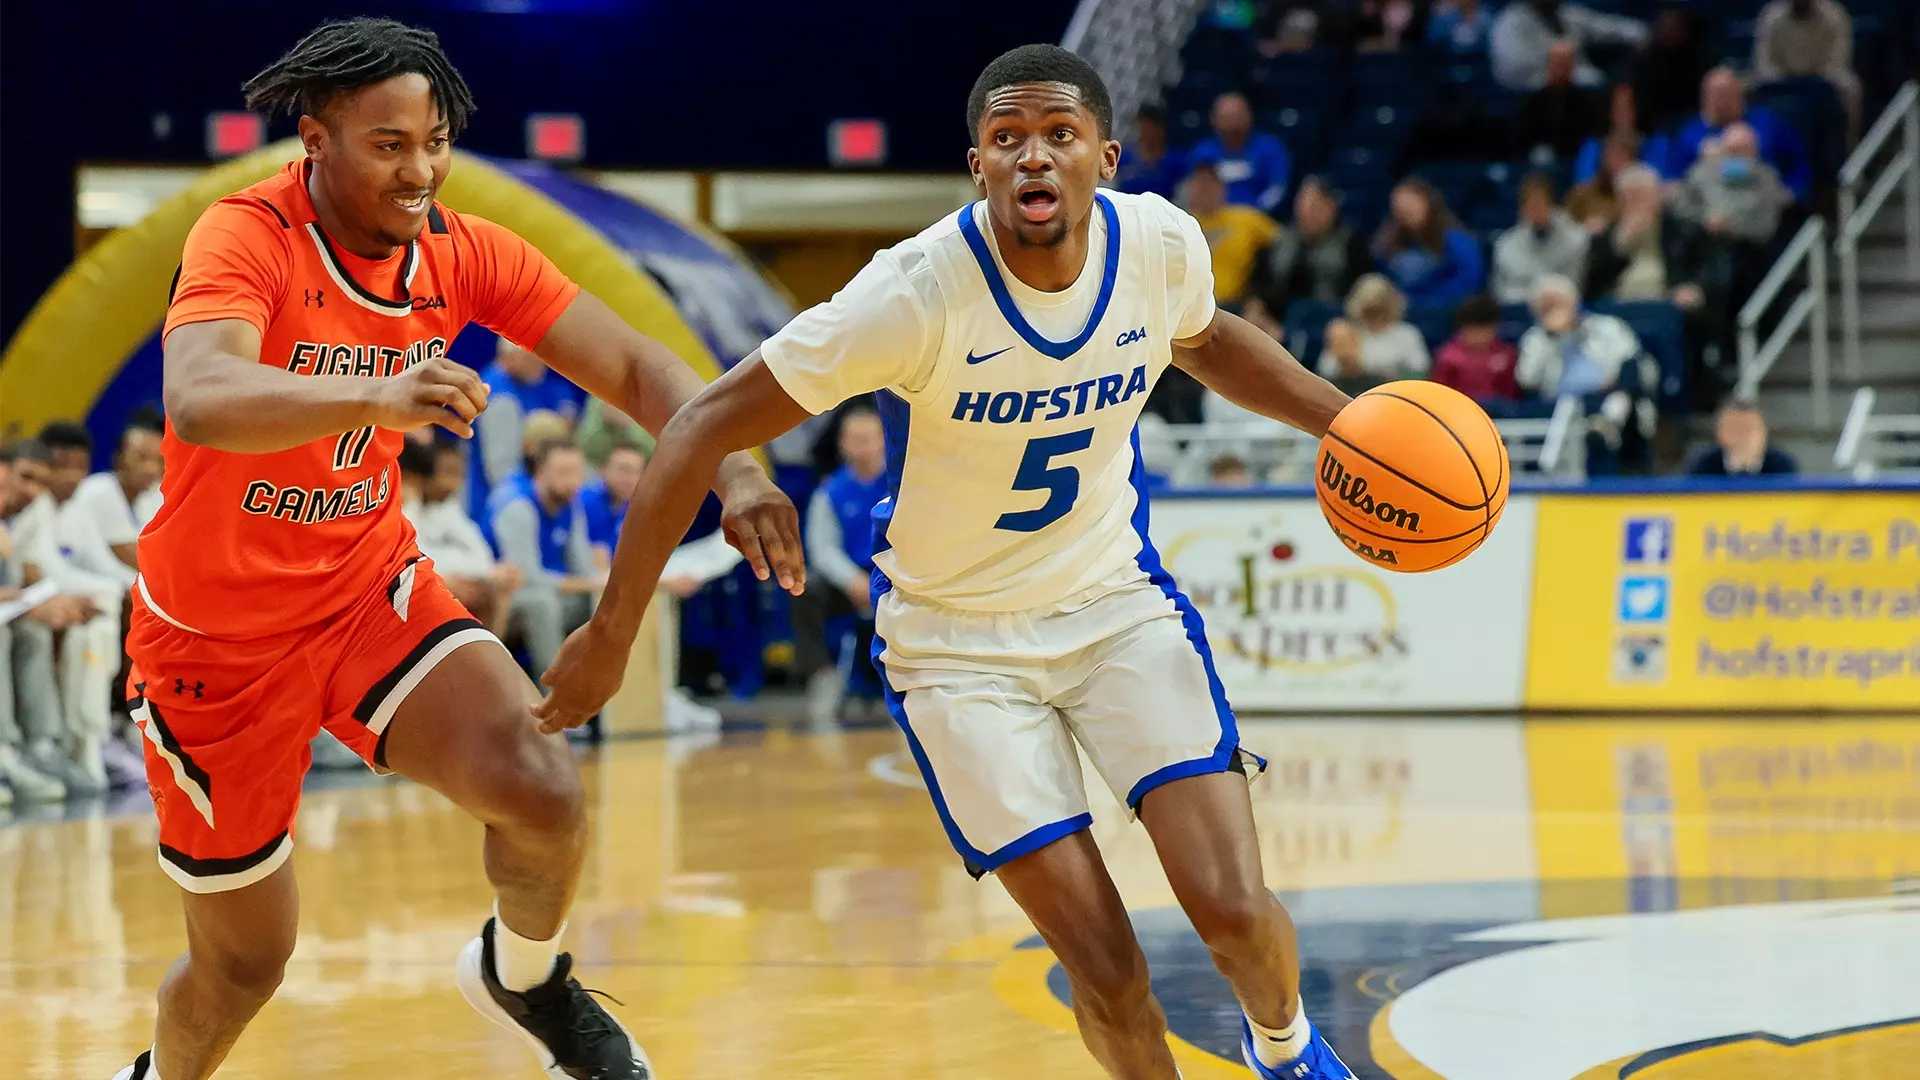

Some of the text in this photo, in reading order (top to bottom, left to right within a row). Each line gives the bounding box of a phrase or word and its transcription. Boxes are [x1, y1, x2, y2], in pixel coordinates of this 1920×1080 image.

[410, 295, 448, 311] CAA
[1115, 326, 1147, 347] CAA
[951, 364, 1147, 424] HOFSTRA
[241, 464, 390, 524] CAMELS
[993, 427, 1096, 533] 5
[1320, 449, 1420, 533] Wilson
[1703, 517, 1873, 562] Hofstra
[1703, 577, 1920, 622] @Hofstra
